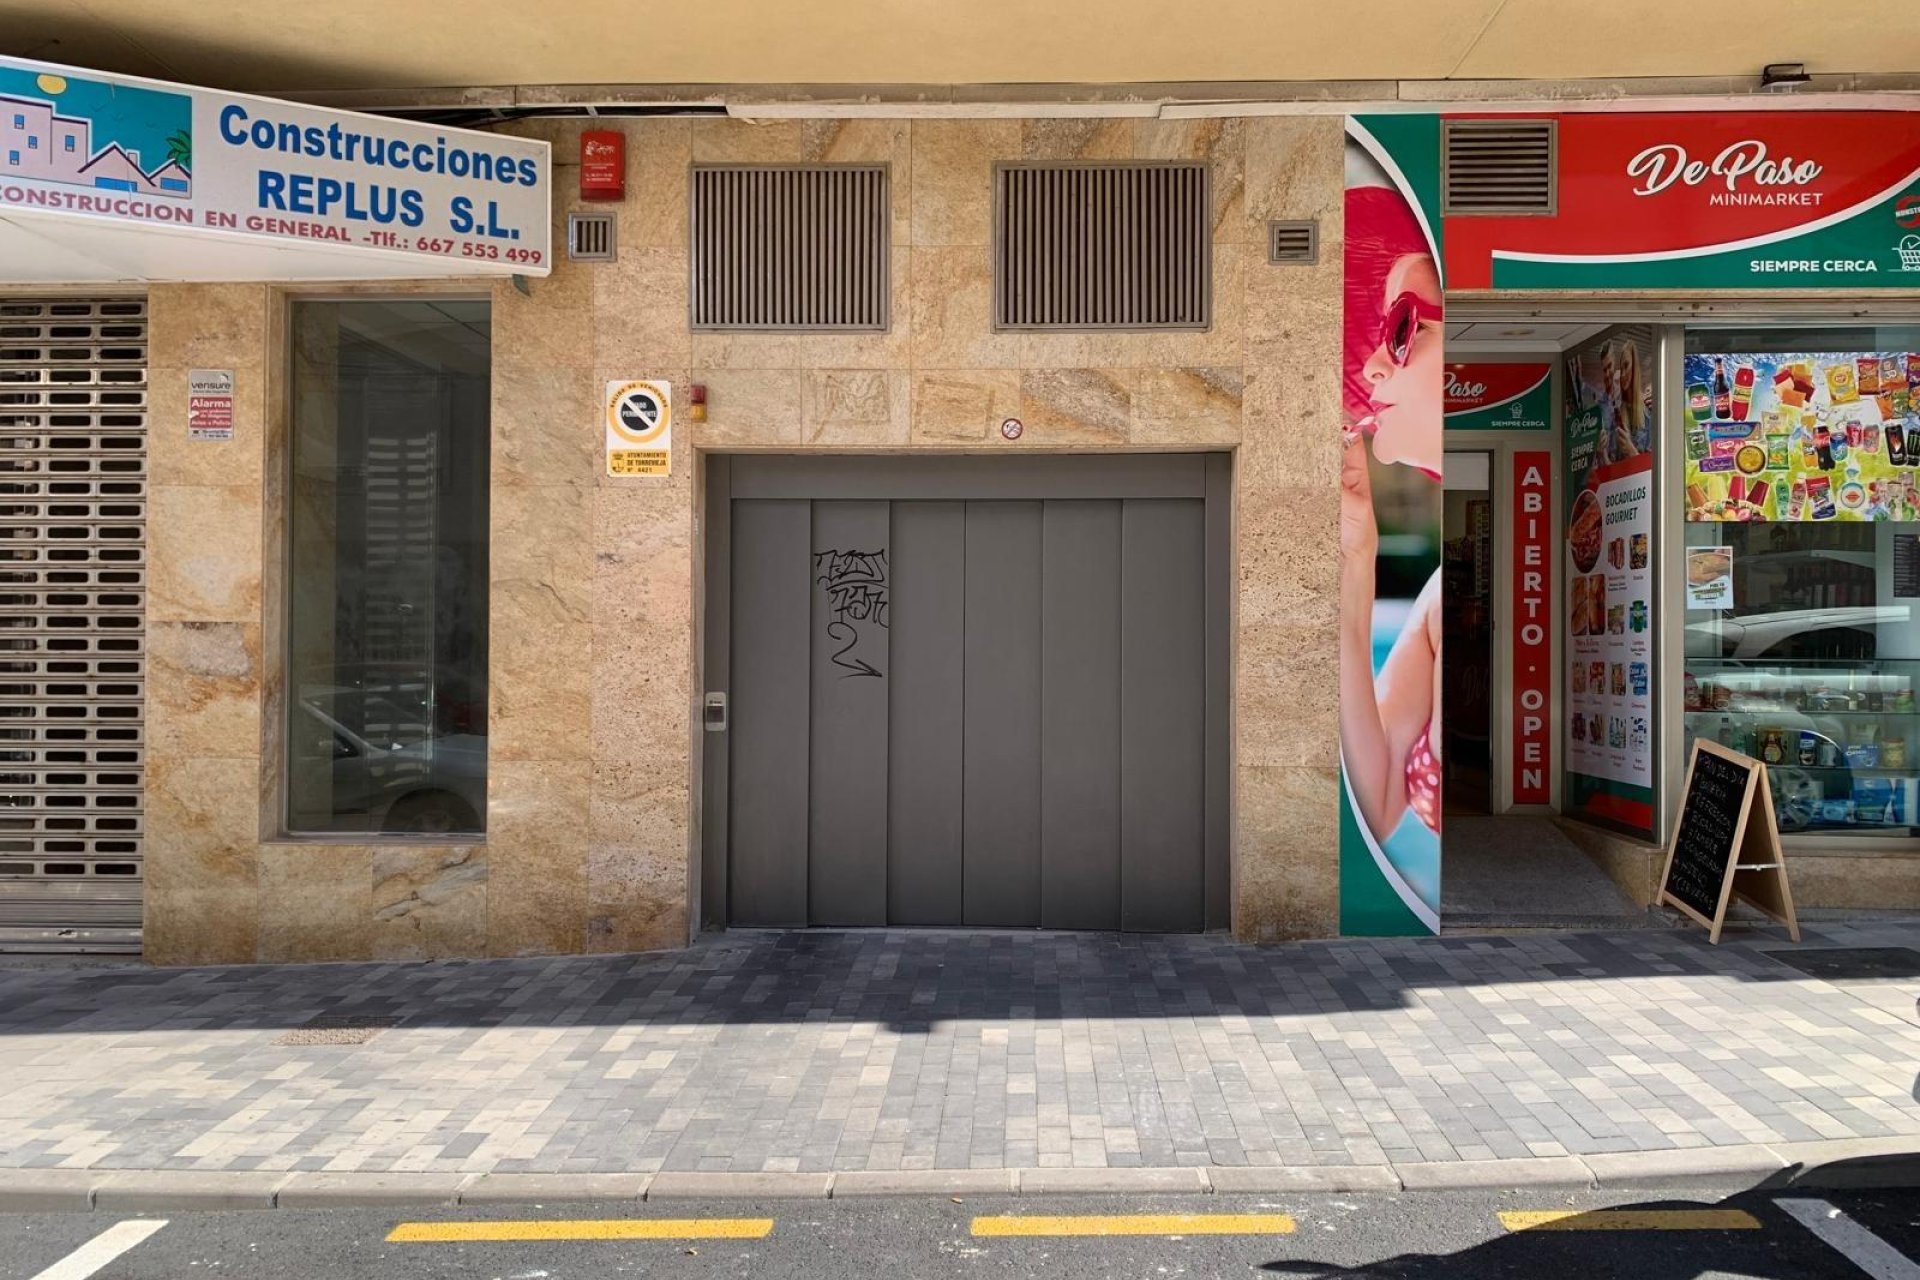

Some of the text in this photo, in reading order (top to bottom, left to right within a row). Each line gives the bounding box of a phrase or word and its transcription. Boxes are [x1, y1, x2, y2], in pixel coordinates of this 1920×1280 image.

[219, 104, 537, 186] Construcciones
[1627, 140, 1823, 196] De Paso
[258, 170, 519, 239] REPLUS S.L.
[1710, 193, 1823, 206] MINIMARKET
[0, 185, 193, 223] ONSTRUCCION
[205, 211, 237, 228] EN
[246, 215, 351, 242] GENERAL
[416, 237, 454, 253] 667
[462, 243, 499, 259] 553
[506, 248, 542, 264] 499
[1750, 260, 1878, 272] SIEMPRE CERCA
[191, 398, 231, 408] Alarma
[1605, 487, 1647, 508] BOCADILLOS
[1605, 507, 1639, 526] GOURMET
[1521, 466, 1544, 790] ABIERTO OPEN
